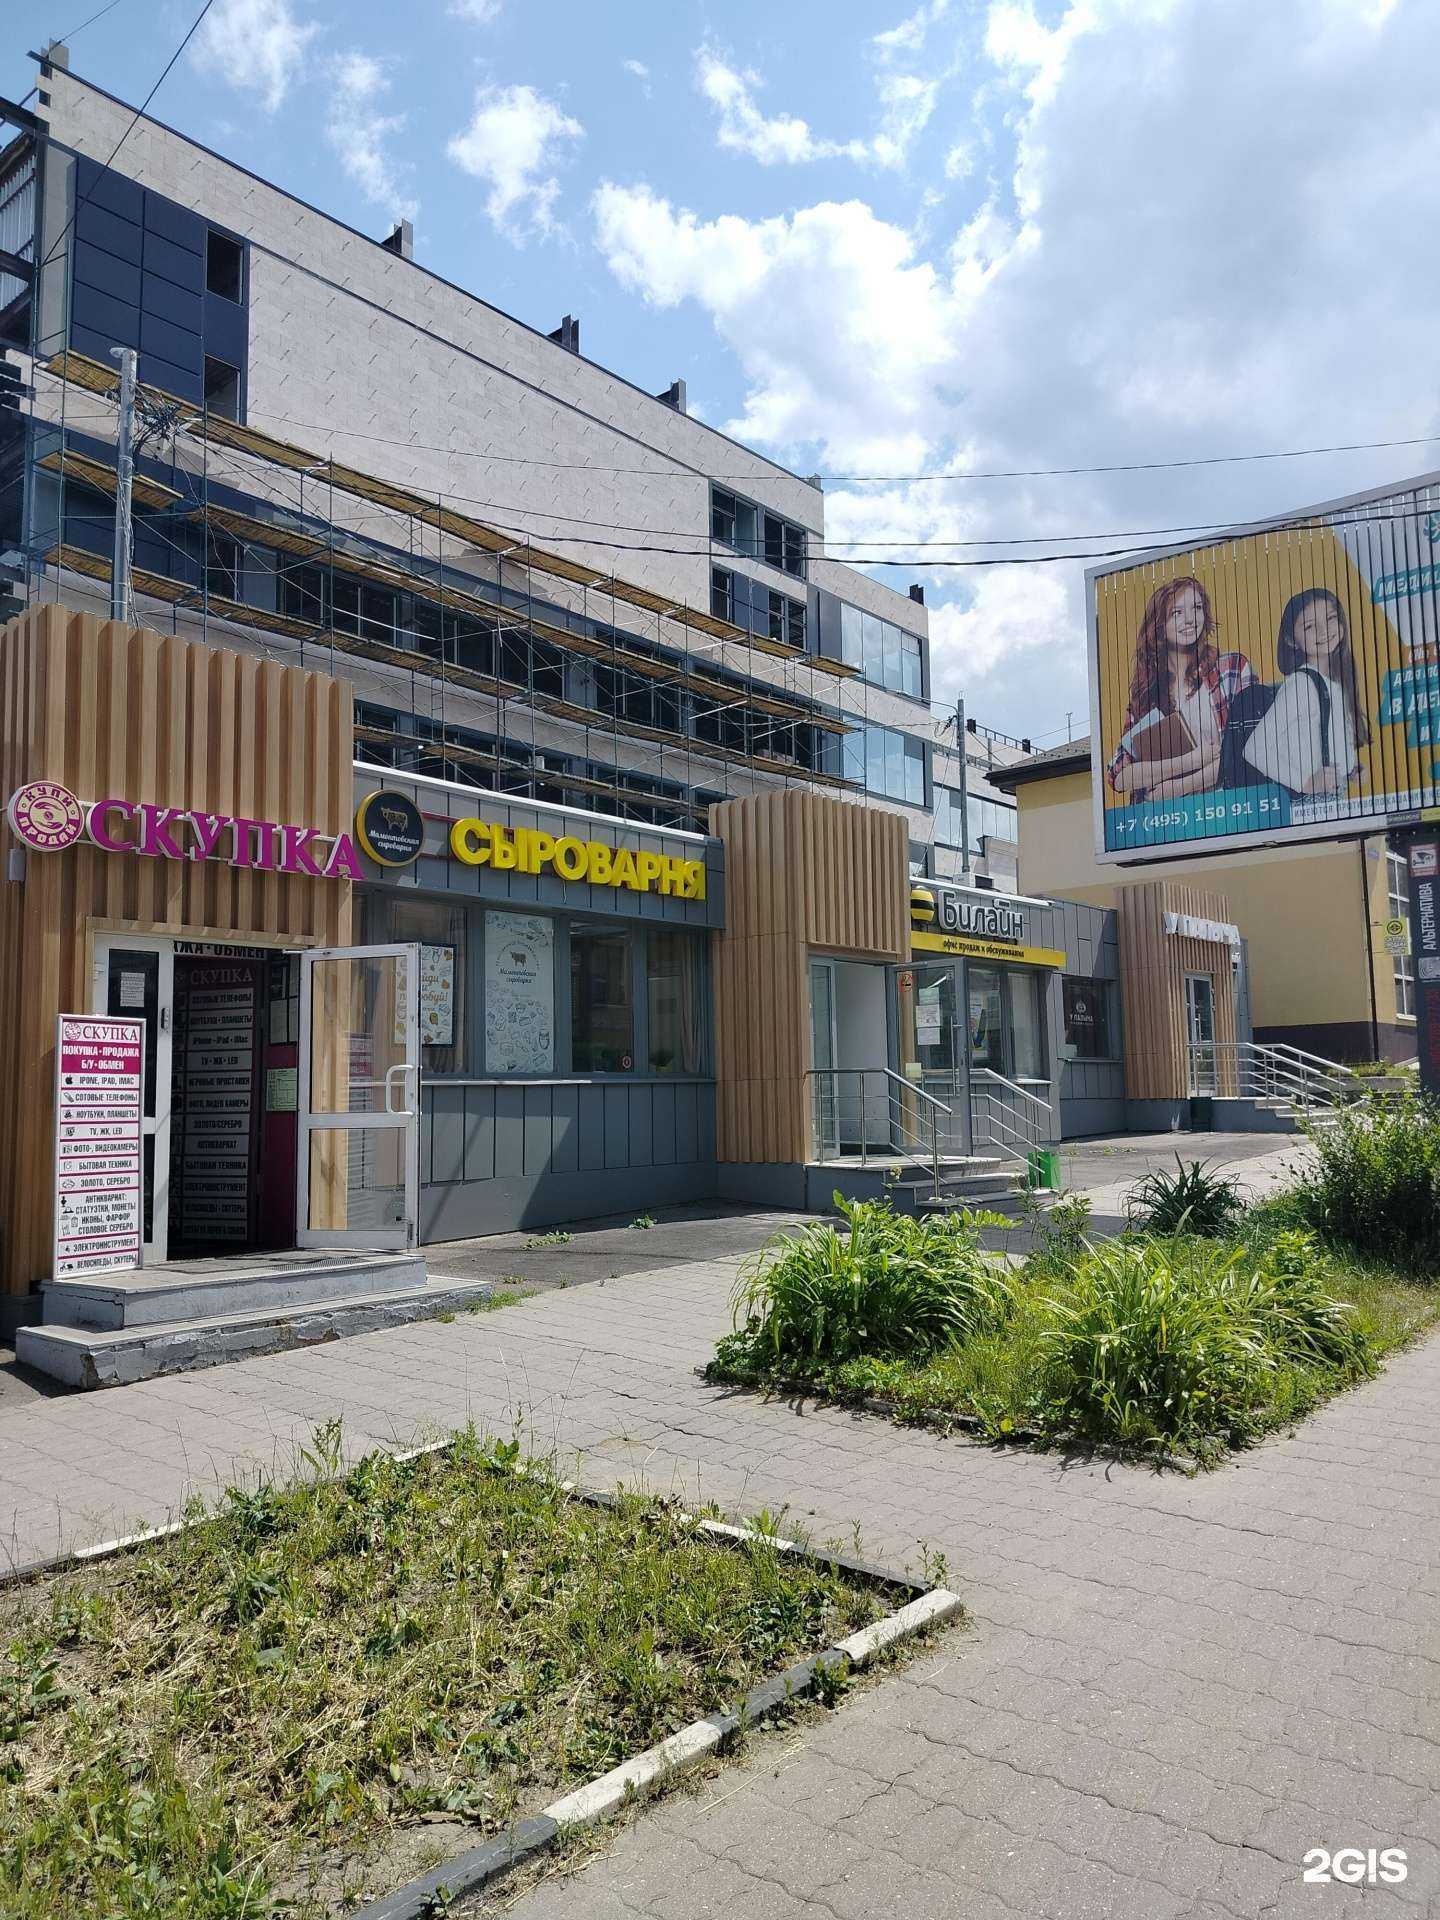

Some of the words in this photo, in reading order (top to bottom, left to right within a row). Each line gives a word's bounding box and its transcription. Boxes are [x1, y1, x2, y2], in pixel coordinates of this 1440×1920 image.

[25, 786, 73, 807] КУПИ
[1116, 819, 1137, 832] +7
[1142, 811, 1189, 831] (495)
[1195, 806, 1226, 822] 150
[1231, 802, 1253, 816] 91
[1259, 797, 1281, 812] 51
[18, 816, 77, 846] ПРОДАЙ
[86, 799, 365, 881] СКУПКА
[450, 817, 707, 900] СЫРОВАРНЯ
[1418, 882, 1437, 950] АЛЬТЕРНАТИВА
[943, 940, 958, 949] офис
[958, 942, 981, 953] продаж
[191, 967, 253, 985] СКУПКА
[83, 1025, 138, 1041] СКУПКА
[63, 1045, 98, 1056] ПОКУПКА
[102, 1046, 140, 1058] ПРОДАЖА
[81, 1060, 94, 1069] Б/У
[98, 1060, 124, 1070] ОБМЕН
[118, 1076, 134, 1085] IMAC
[75, 1093, 104, 1102] СОТОВЫЕ
[106, 1093, 138, 1102] ТЕЛЕФОНЫ
[107, 1109, 137, 1118] ПЛАНШЕТЫ
[113, 1127, 122, 1135] LED
[95, 1143, 138, 1153] ВИДЕОКАМЕРЫ
[79, 1161, 106, 1170] БЫТОВАЯ
[108, 1159, 132, 1169] ТЕХНИКА
[81, 1178, 105, 1187] ЗОЛОТО,
[106, 1177, 131, 1186] СЕРЕБРО
[111, 1202, 136, 1212] МОНЕТЫ
[106, 1213, 131, 1222] ФАРФОР
[78, 1224, 108, 1235] СТОЛОВОЕ
[109, 1222, 134, 1232] СЕРЕБРО
[73, 1238, 136, 1252] ЭЛЕКТРОИНСТРУМЕНТ
